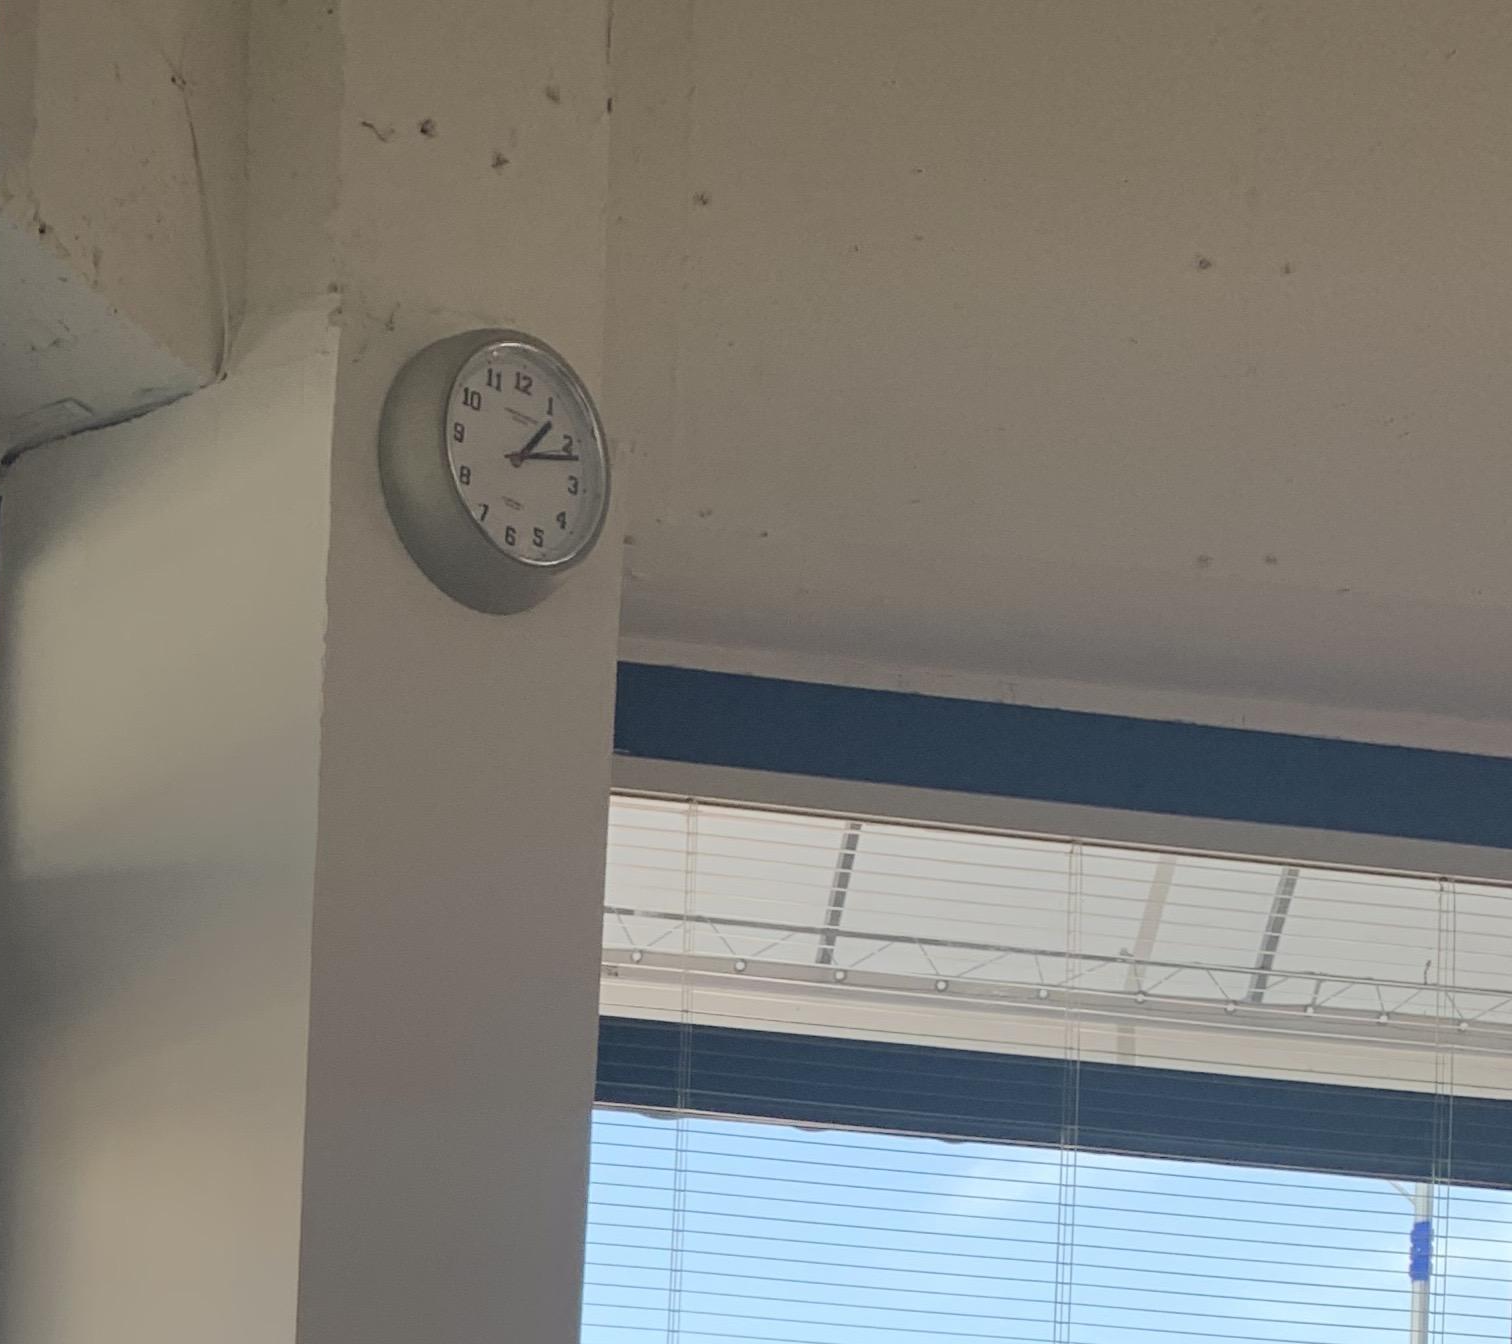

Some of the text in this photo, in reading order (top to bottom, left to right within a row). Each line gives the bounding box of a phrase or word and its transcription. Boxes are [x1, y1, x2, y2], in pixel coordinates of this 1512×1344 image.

[485, 368, 502, 392] 11
[514, 371, 533, 396] 12
[462, 387, 482, 411] 10
[546, 397, 554, 416] 1
[453, 422, 465, 443] 9
[562, 435, 574, 454] 2
[459, 465, 471, 486] 8
[567, 476, 579, 496] 3
[478, 503, 489, 523] 7
[556, 511, 567, 530] 4
[504, 526, 517, 546] 6
[532, 527, 545, 548] 5
